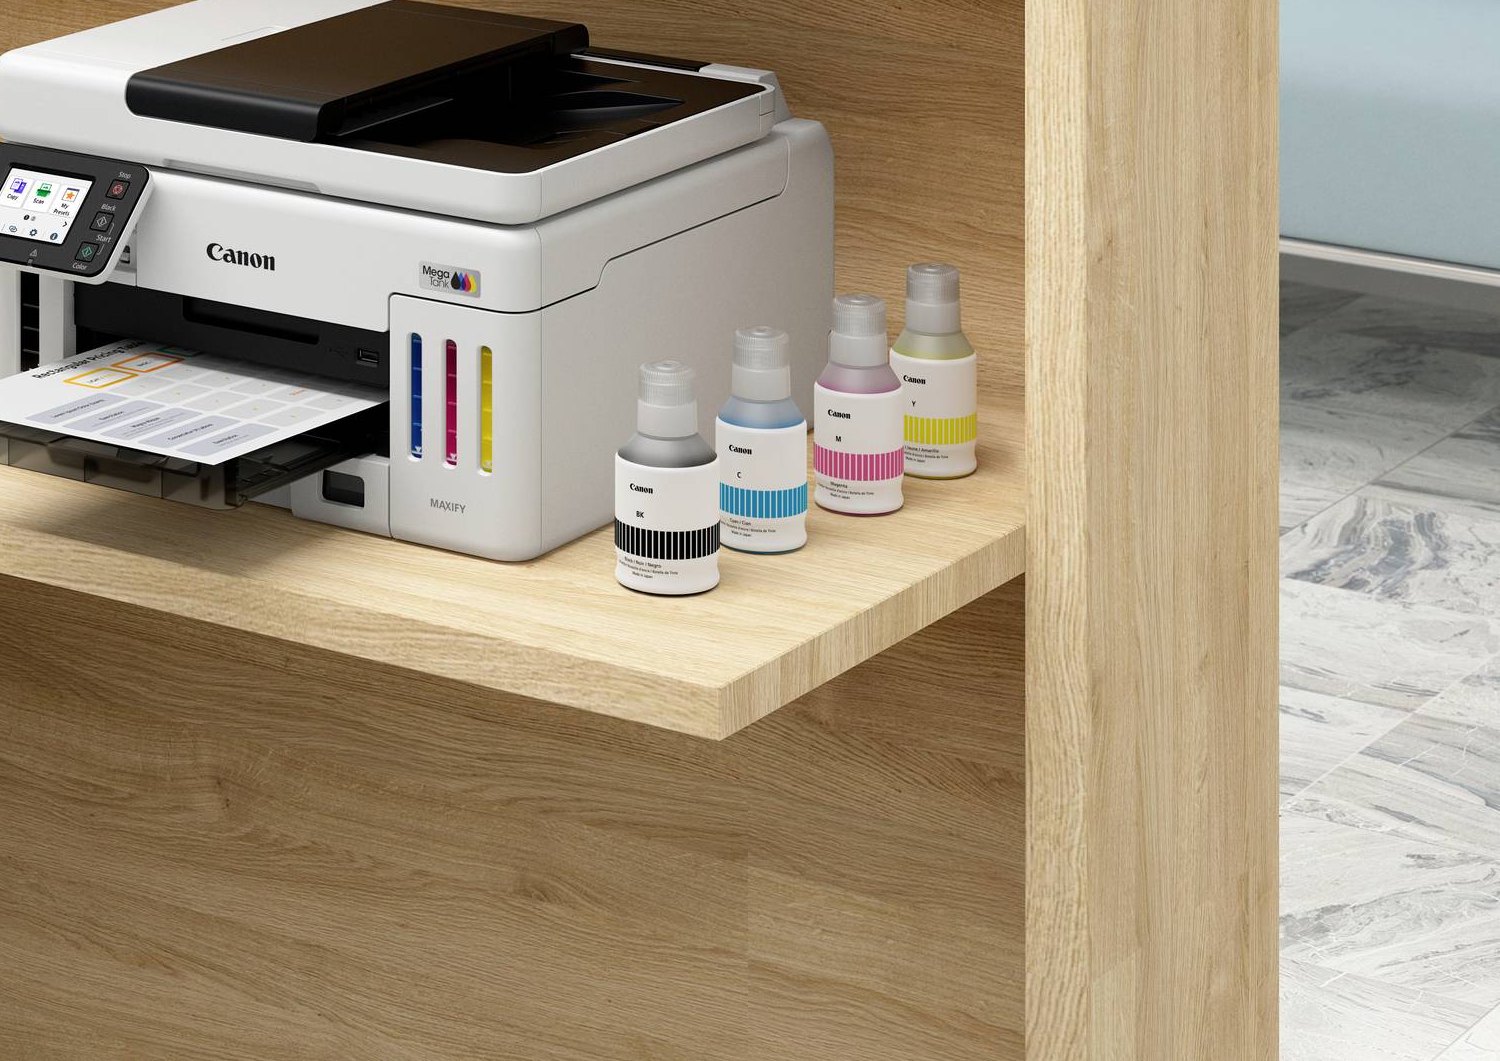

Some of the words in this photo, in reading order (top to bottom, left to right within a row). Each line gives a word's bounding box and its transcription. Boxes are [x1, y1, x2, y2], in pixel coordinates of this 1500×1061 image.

[117, 171, 132, 180] Stop
[6, 192, 20, 202] Copy
[32, 197, 46, 205] Scan
[60, 202, 70, 211] My
[100, 202, 117, 212] Black
[52, 207, 71, 218] Presets
[95, 233, 113, 243] Start
[205, 242, 276, 272] Canon
[72, 261, 89, 271] Color
[422, 265, 450, 280] Mega
[430, 276, 450, 290] Tank
[902, 374, 927, 386] Canon
[910, 399, 917, 408] Y
[827, 408, 852, 420] Canon
[834, 434, 843, 443] M
[728, 443, 753, 456] Canon
[736, 471, 743, 480] C
[628, 482, 654, 495] Canon
[430, 497, 467, 515] MAXIFY
[635, 510, 646, 519] BK
